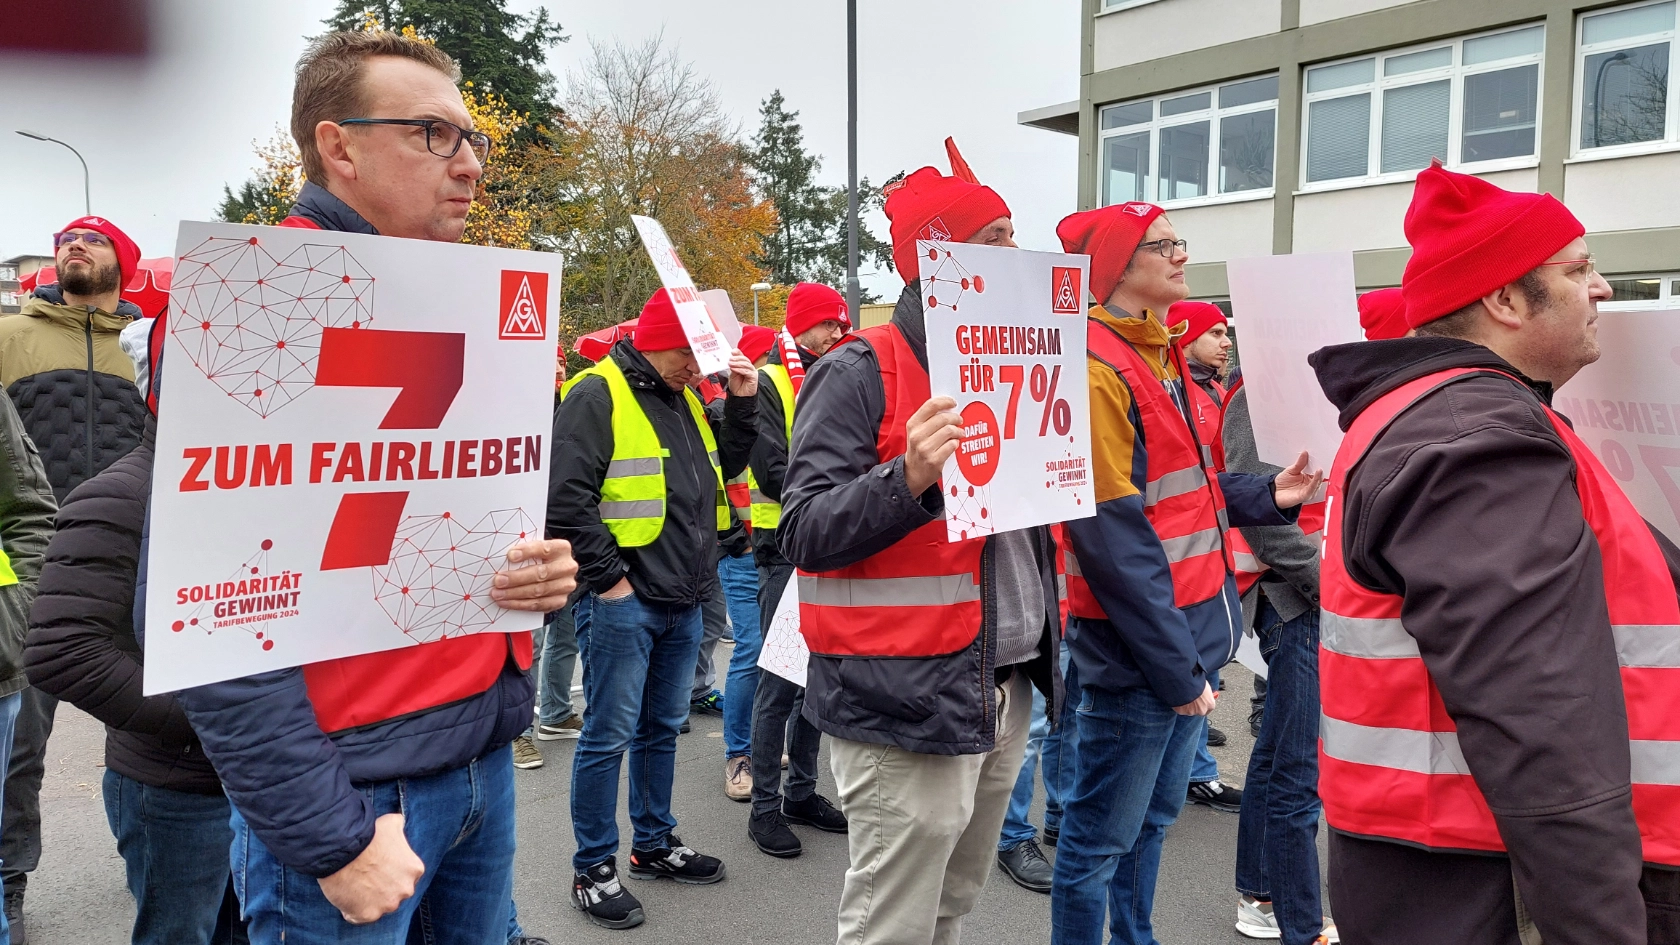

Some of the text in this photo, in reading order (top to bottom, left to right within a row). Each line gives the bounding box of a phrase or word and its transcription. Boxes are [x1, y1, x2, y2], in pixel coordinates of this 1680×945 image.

[955, 324, 1062, 355] GEMEINSAM
[959, 357, 1072, 440] FÜR 7%
[964, 421, 988, 438] DAFÜR
[960, 435, 994, 454] STREITEN
[179, 434, 542, 492] ZUM FAIRLIEBEN
[970, 452, 988, 467] WIR!
[1045, 456, 1086, 472] SOLIDARITÄT
[1058, 469, 1087, 482] GEWINNT
[176, 570, 302, 605] SOLIDARITÄT
[213, 591, 301, 618] GEWINNT
[213, 609, 299, 629] TARIFBEWEGUNG 2024
